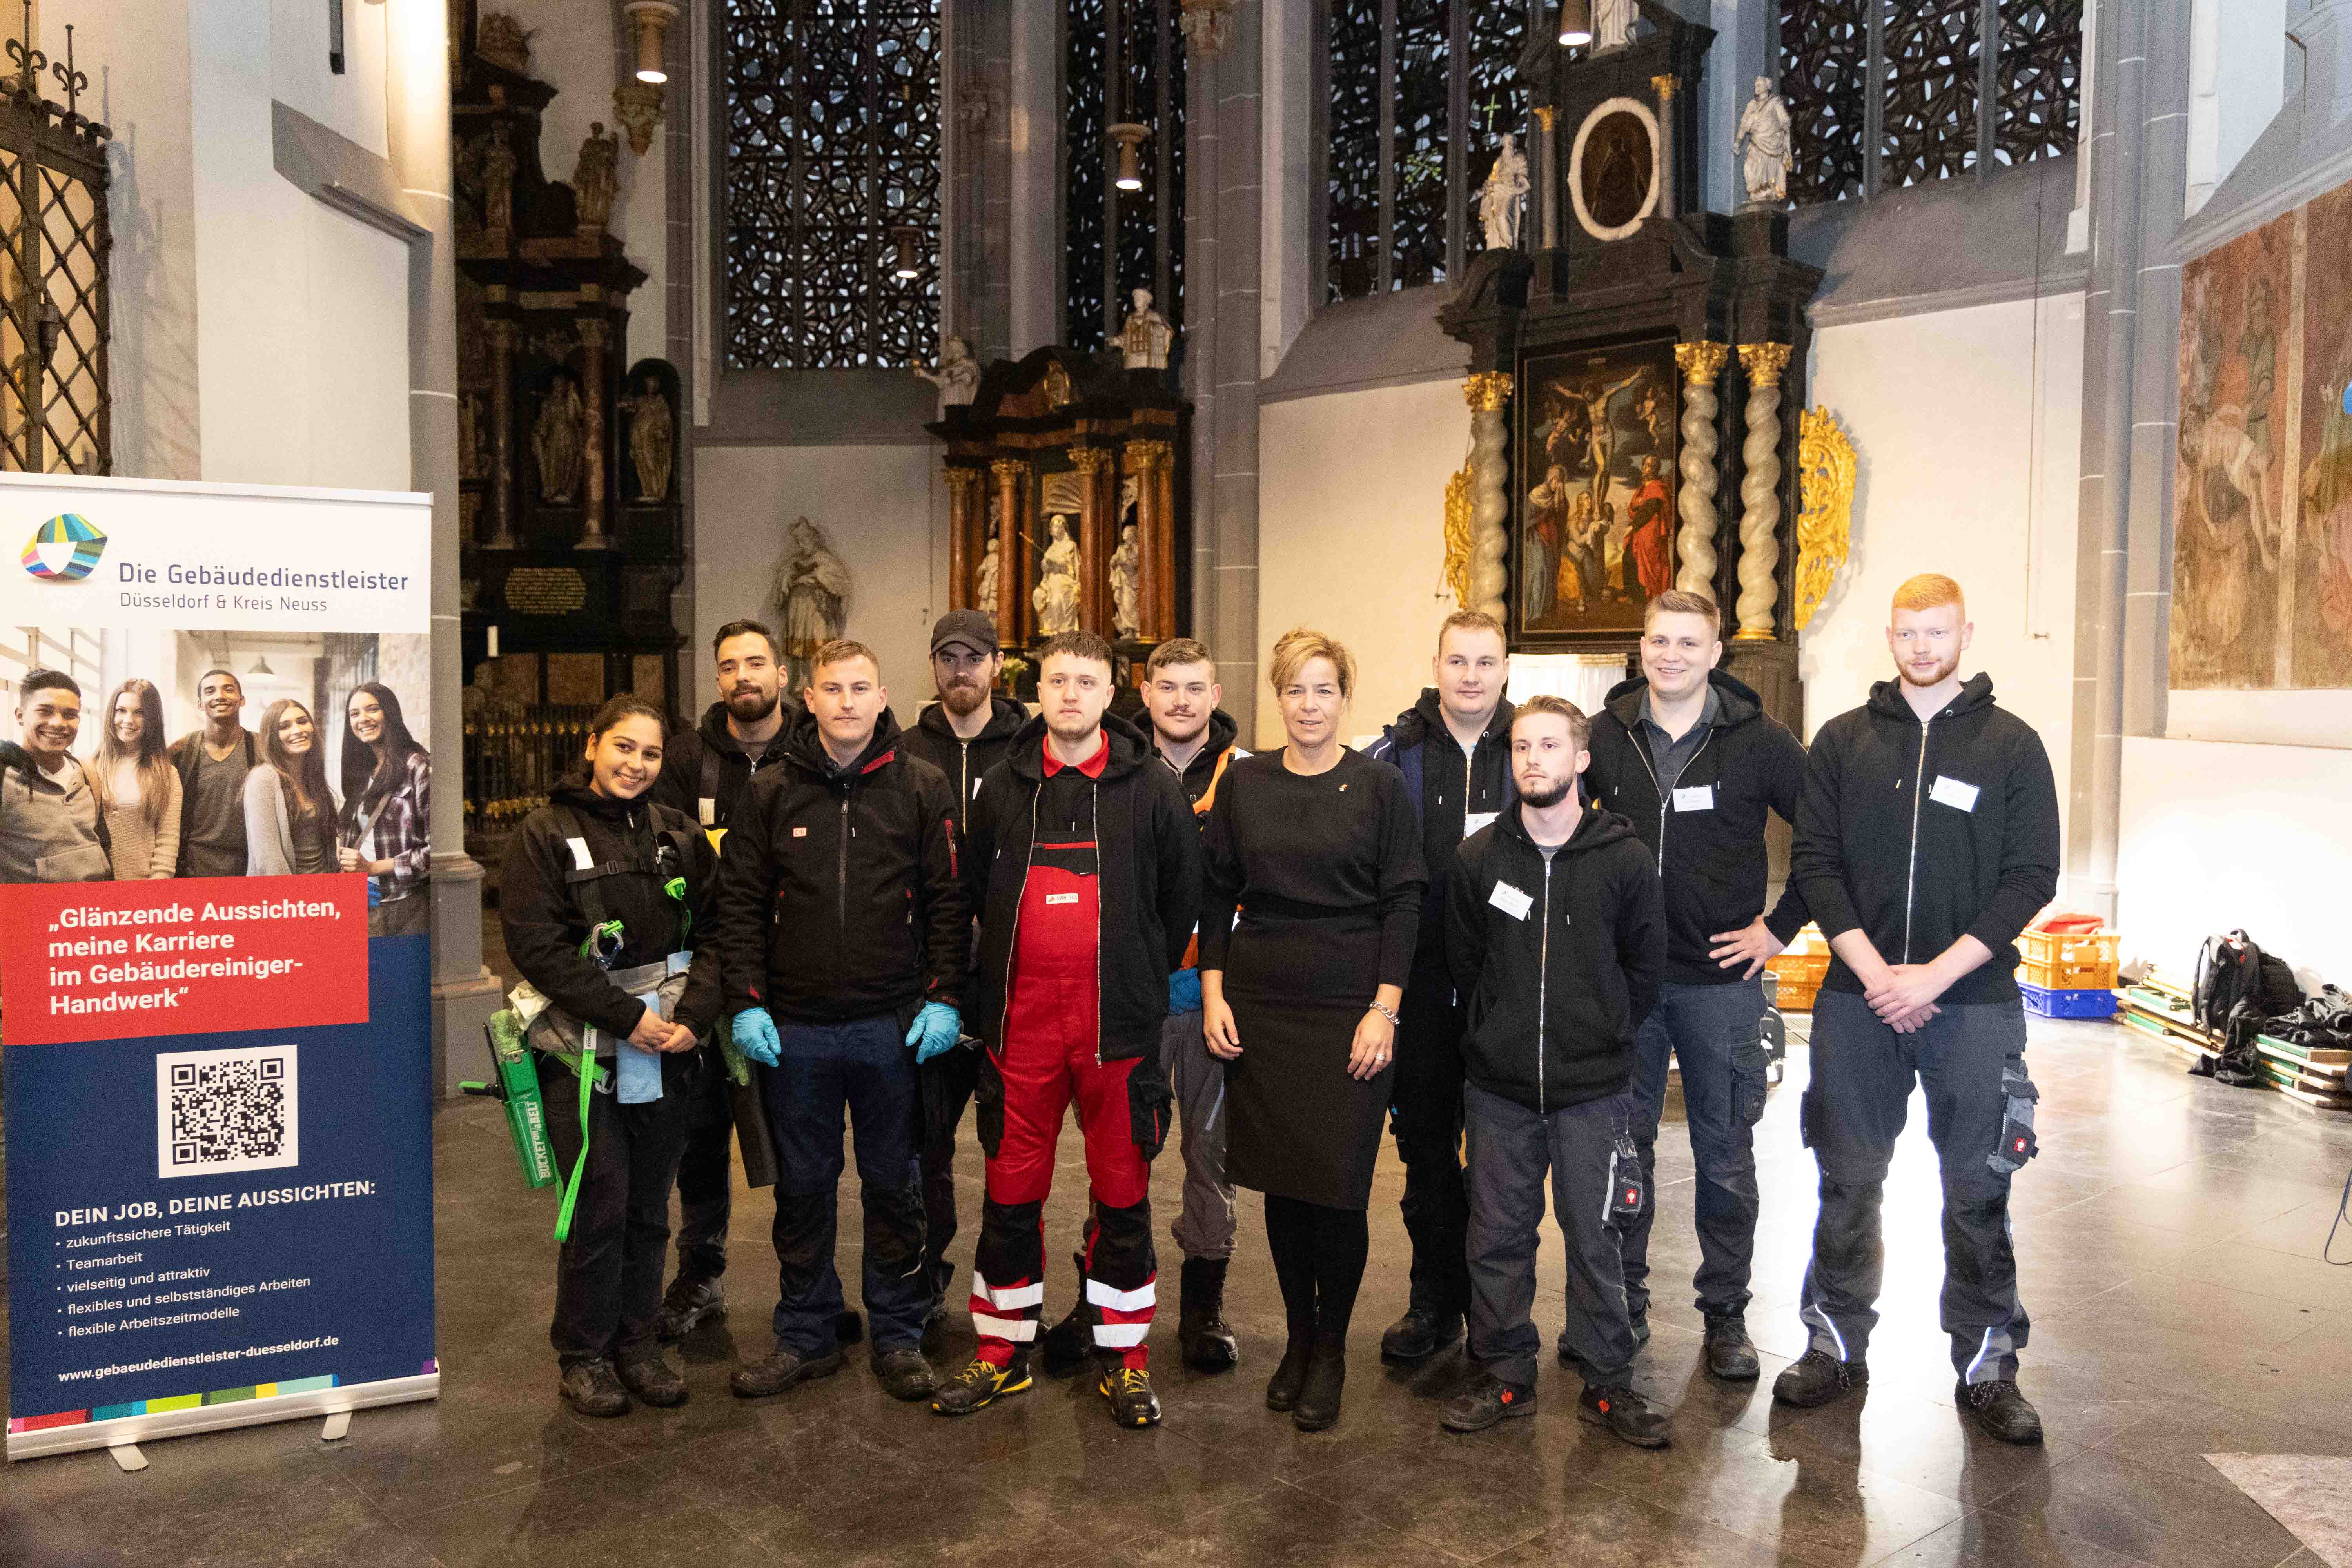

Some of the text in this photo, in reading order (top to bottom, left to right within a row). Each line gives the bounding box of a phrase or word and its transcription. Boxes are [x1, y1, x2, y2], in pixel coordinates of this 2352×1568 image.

[120, 563, 408, 590] Die Gebäudedienstleister
[120, 592, 327, 611] Düsseldorf & Kreis Neuss
[49, 899, 341, 932] „Glänzende Aussichten,
[49, 931, 234, 957] meine Karriere
[50, 956, 303, 986] im Gebäudereiniger-
[51, 987, 189, 1015] Handwerk“
[526, 1101, 541, 1123] BELT
[534, 1141, 552, 1179] BUCKET
[56, 1180, 375, 1227] DEIN JOB, DEINE AUSSICHTEN:
[66, 1221, 230, 1248] zukunftssichere Tätigkeit
[66, 1252, 142, 1270] Teamarbeit
[67, 1267, 210, 1292] vielseitig und attraktiv
[67, 1278, 310, 1315] flexibles und selbstständiges Arbeiten
[68, 1307, 240, 1337] flexible Arbeitszeitmodelle
[58, 1335, 339, 1382] www.gebaeudedienstleister-duesseldorf.de
